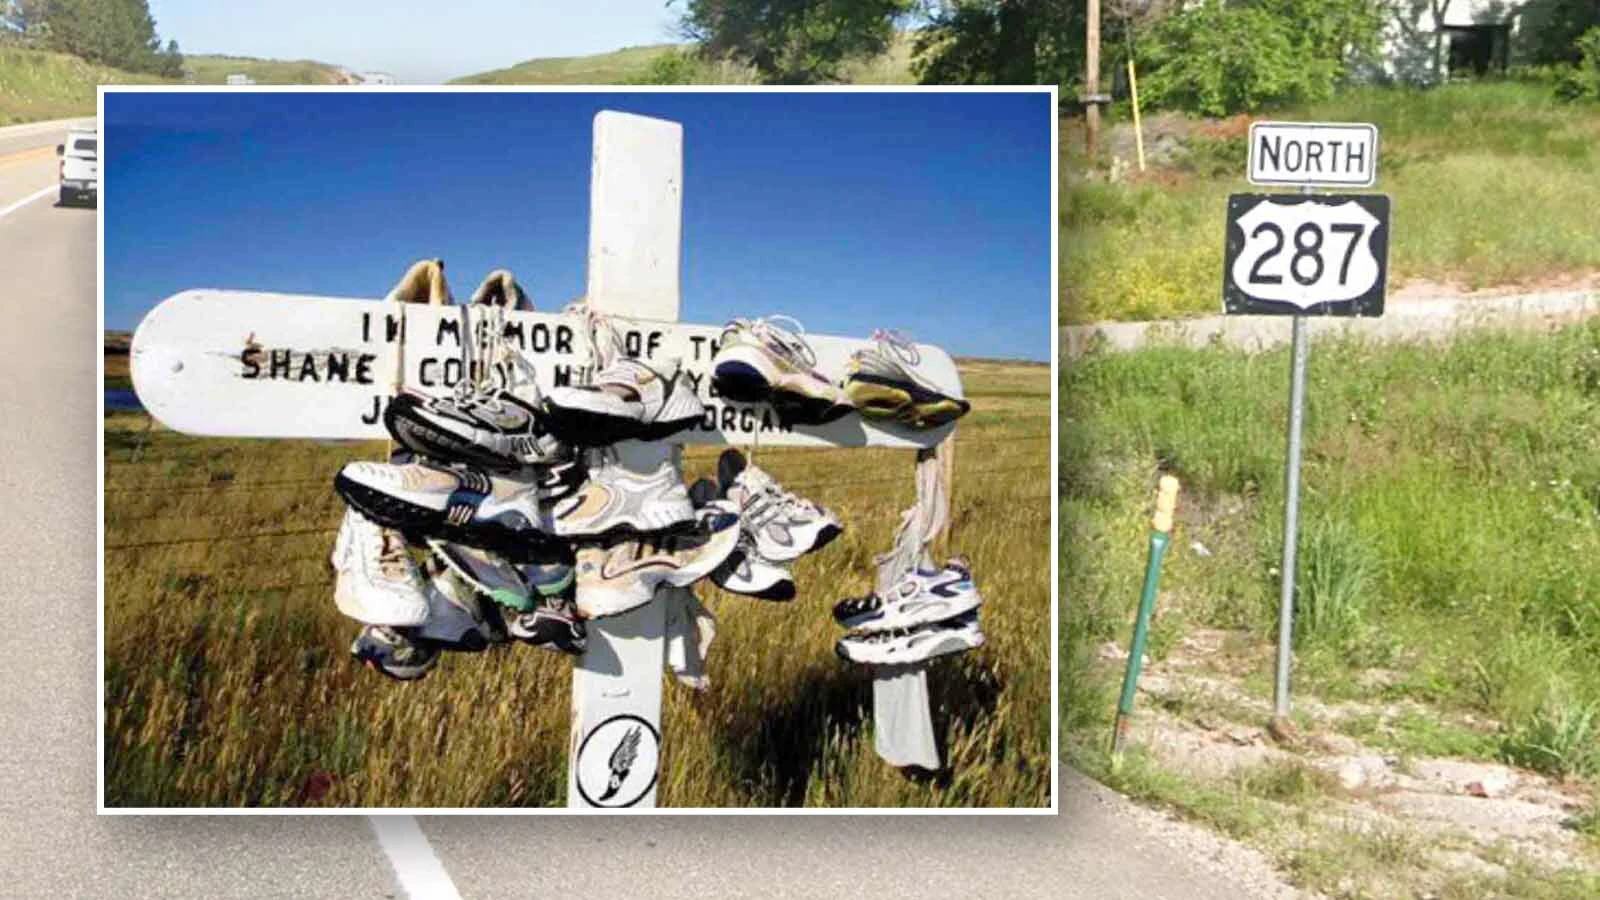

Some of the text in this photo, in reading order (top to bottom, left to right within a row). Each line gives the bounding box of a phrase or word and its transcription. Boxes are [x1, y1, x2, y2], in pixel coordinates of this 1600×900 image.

[1259, 135, 1365, 173] NORTH
[1248, 221, 1366, 286] 287
[436, 317, 574, 354] MEMOR
[625, 330, 663, 359] OF
[689, 336, 721, 361] TH
[240, 349, 377, 384] SHANE
[687, 404, 794, 433] ORGAN
